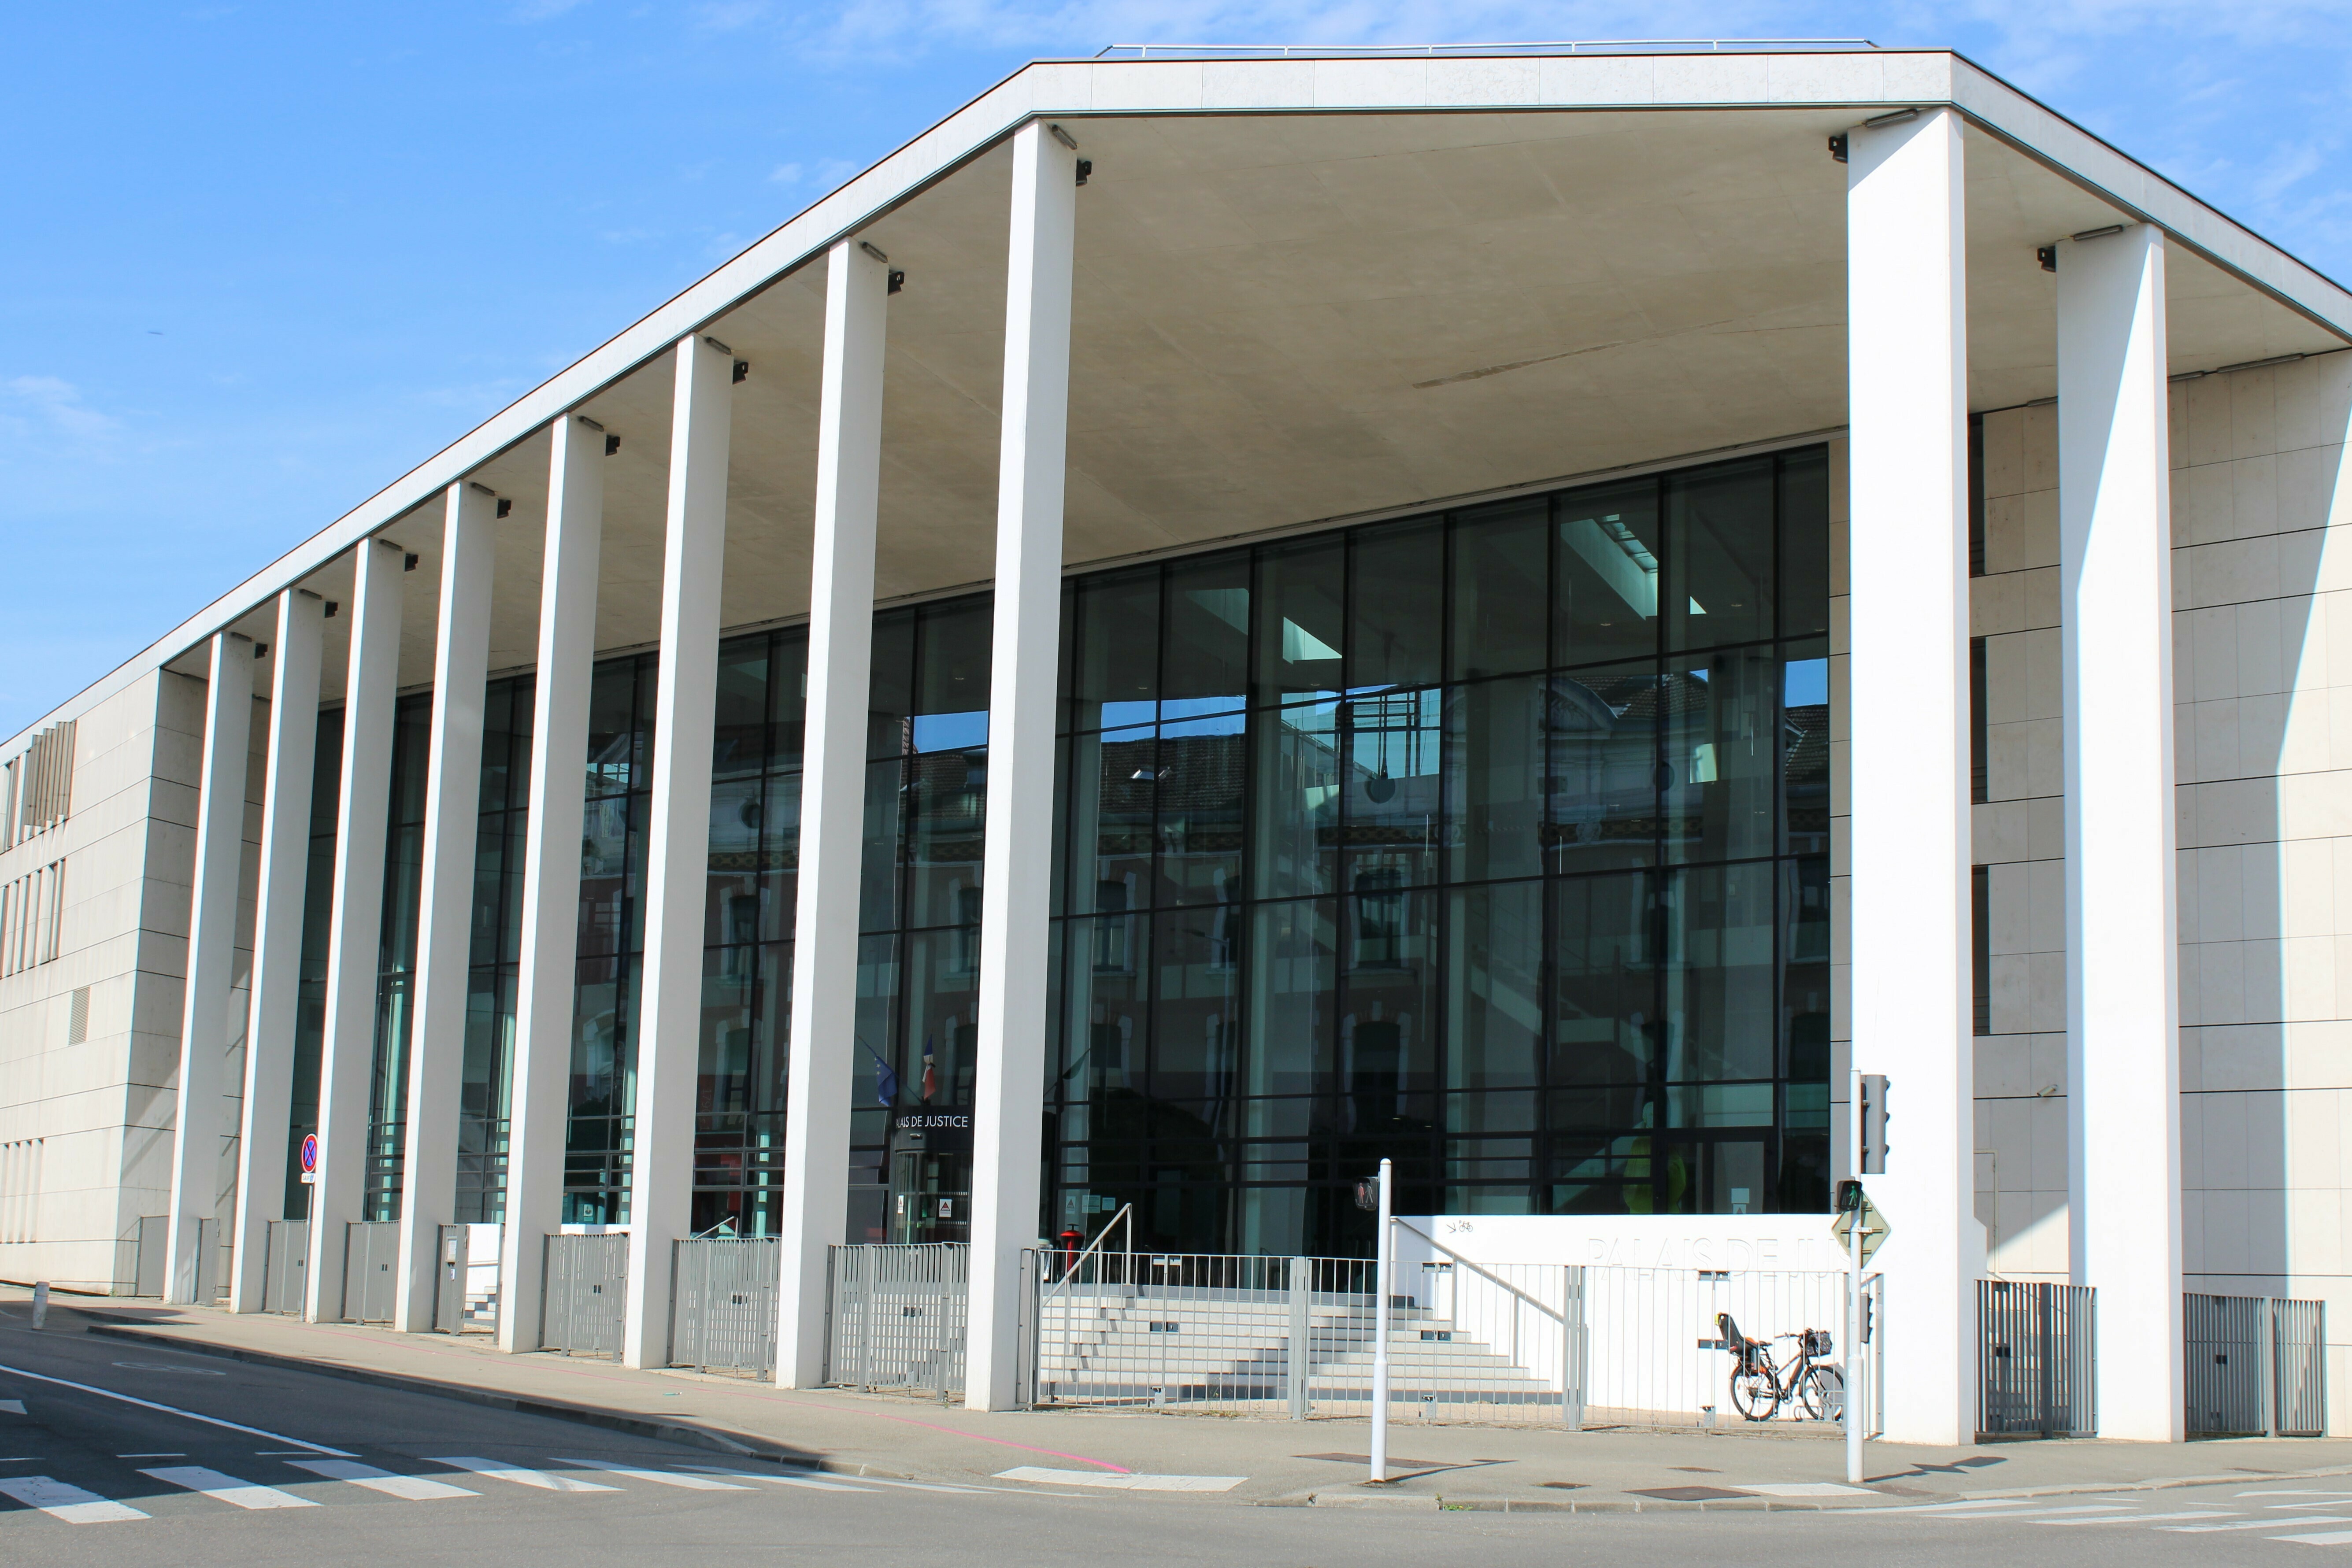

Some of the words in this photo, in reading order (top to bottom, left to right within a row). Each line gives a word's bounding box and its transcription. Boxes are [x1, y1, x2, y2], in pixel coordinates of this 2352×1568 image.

[911, 1116, 922, 1127] DE
[925, 1116, 968, 1128] JUSTICE
[1588, 1237, 1713, 1282] PALAIS
[1726, 1238, 1778, 1282] DE
